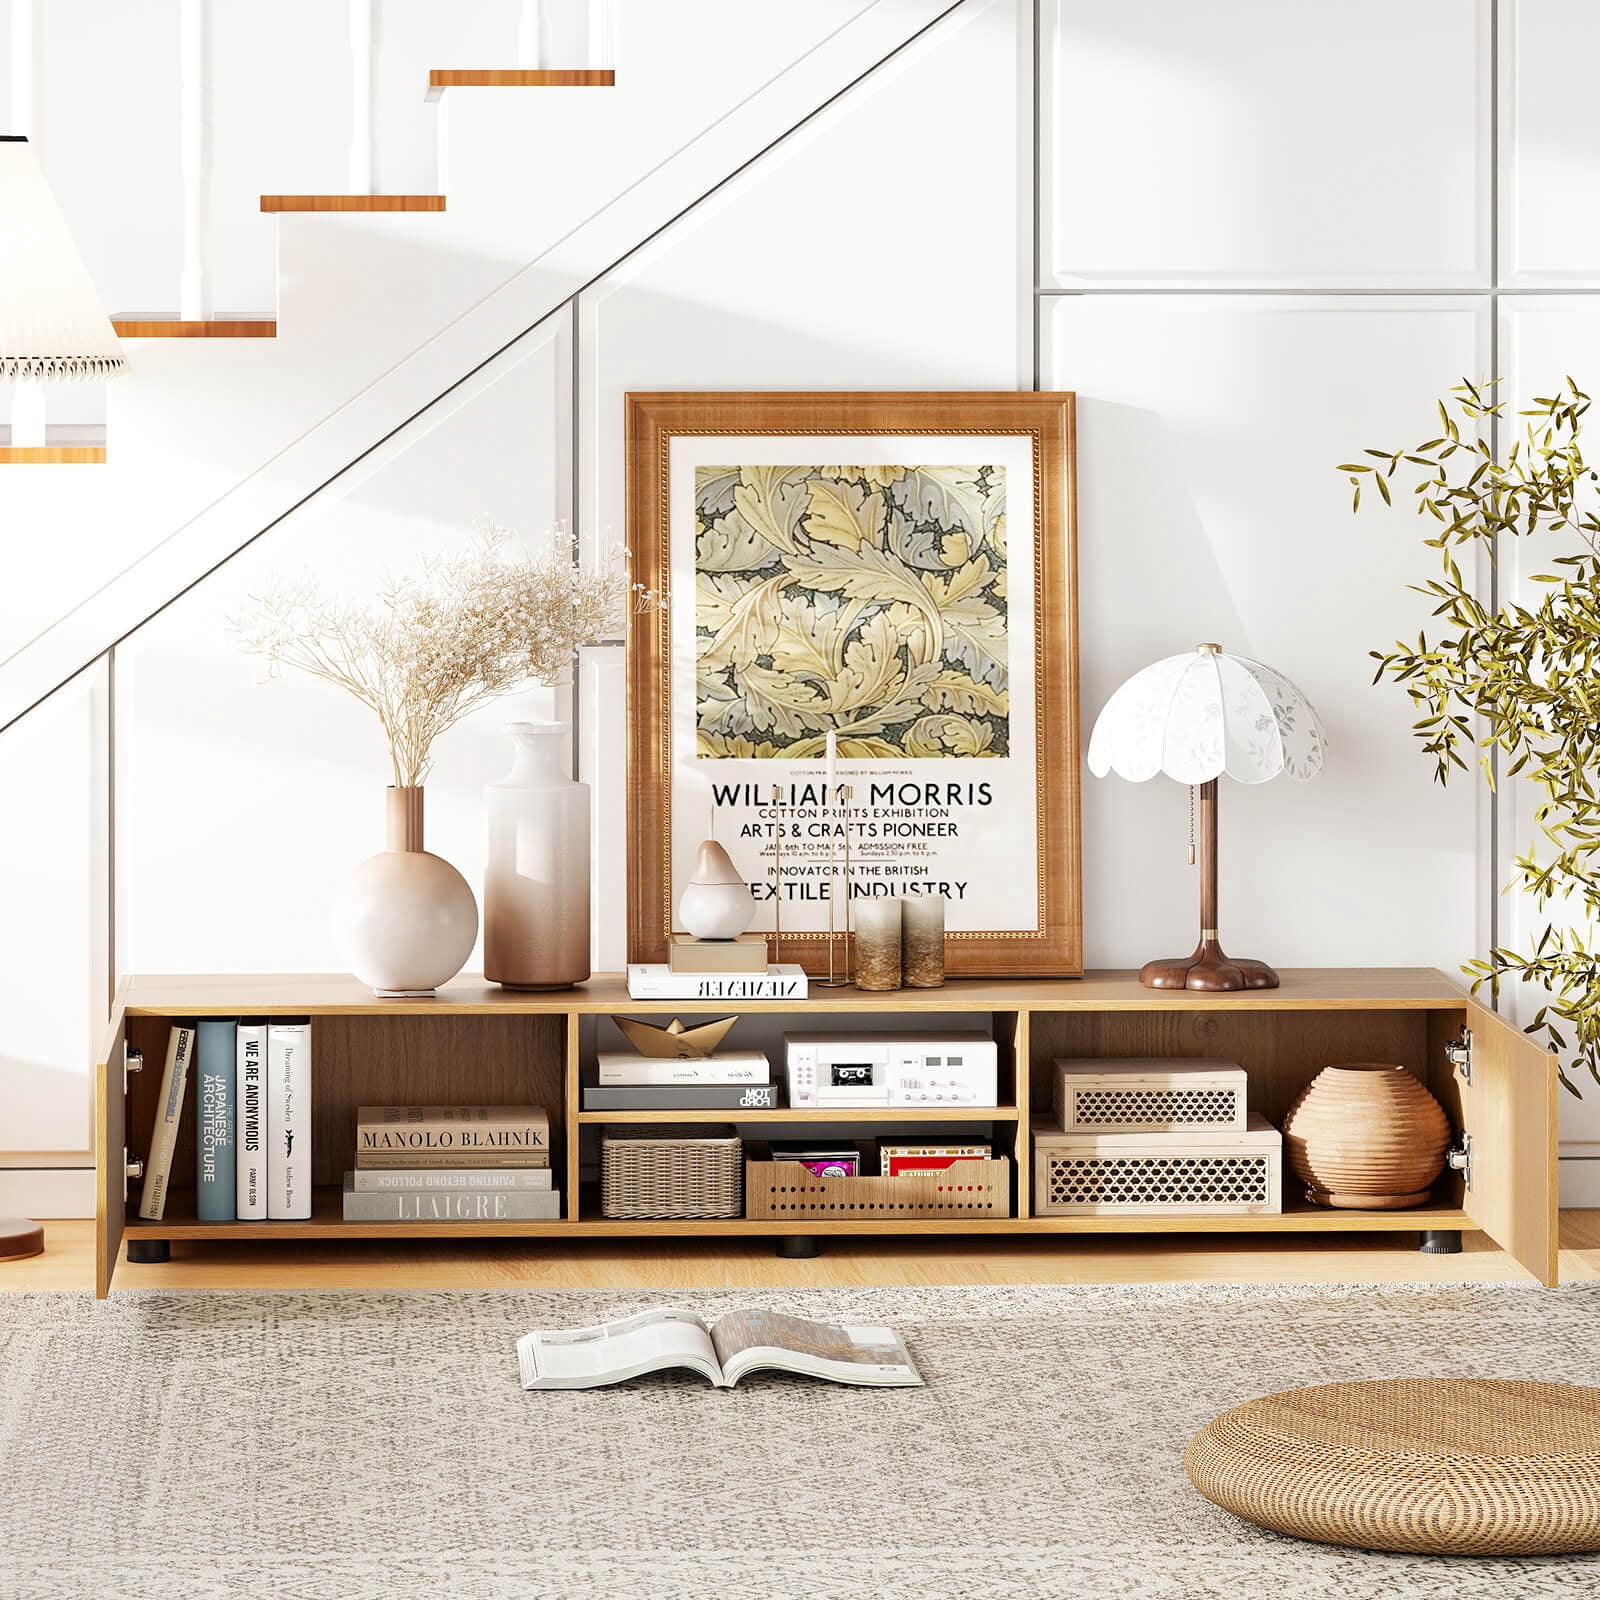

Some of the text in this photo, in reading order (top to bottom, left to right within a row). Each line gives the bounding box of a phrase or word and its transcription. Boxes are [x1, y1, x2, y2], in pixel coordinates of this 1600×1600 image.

[870, 783, 992, 806] MORRIS
[758, 808, 817, 819] COTTON
[873, 807, 949, 818] EXHIBITION
[740, 823, 959, 838] ARTS & CRAFTS PIONEER
[802, 843, 815, 851] TO
[907, 842, 928, 850] FREE
[768, 866, 928, 876] INNOVATOR IN THE BRITISH
[746, 882, 830, 900] EXTILE
[283, 1048, 293, 1083] Dreaming
[246, 1040, 259, 1151] WE ARE ANONYMOUS
[215, 1075, 226, 1146] JAPANESE
[284, 1093, 293, 1122] Sweden
[203, 1074, 215, 1182] ARCHITECTURE
[363, 1128, 544, 1148] MANOLO BLAHNÍK
[249, 1168, 257, 1206] PARMY OLSON
[377, 1176, 422, 1186] POLLOCK
[427, 1176, 466, 1186] BEYOND
[470, 1176, 515, 1186] PAINTING
